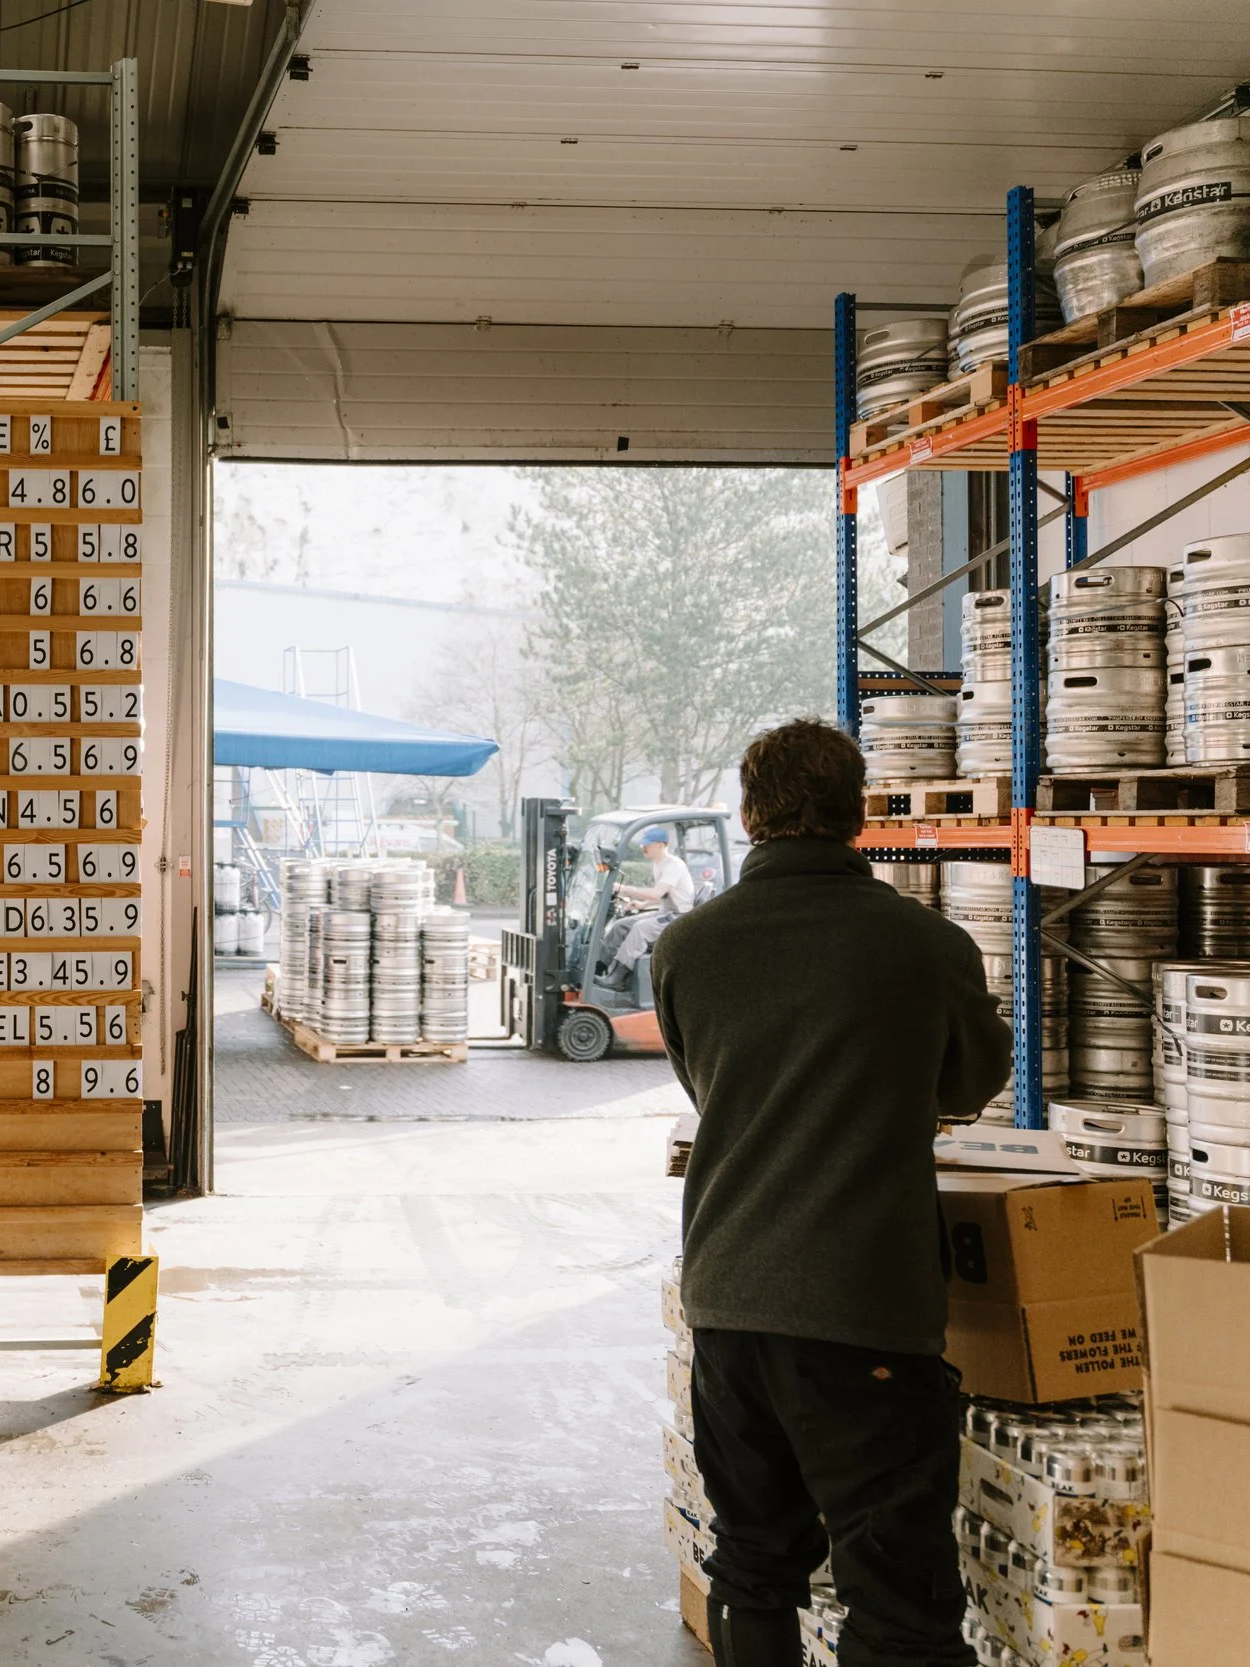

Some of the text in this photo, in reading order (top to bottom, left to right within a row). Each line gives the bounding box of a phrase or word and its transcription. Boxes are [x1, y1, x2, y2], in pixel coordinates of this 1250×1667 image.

[32, 423, 50, 450] %
[104, 425, 117, 451] £
[11, 477, 67, 504] 4.8
[81, 478, 136, 504] 6.0
[34, 532, 49, 557] 5
[81, 532, 138, 558] 5.8
[33, 583, 49, 610] 6
[82, 584, 137, 612] 6.6
[1204, 601, 1228, 610] Kegstar
[32, 638, 47, 664] 5
[79, 639, 134, 665] 6.8
[13, 691, 68, 718] 0.5
[84, 691, 138, 718] 5.2
[1115, 724, 1141, 732] Kegstar
[11, 742, 66, 772] 6.5
[84, 744, 138, 771] 6.9
[20, 798, 76, 824] 4.5
[99, 798, 114, 824] 6
[7, 852, 62, 878] 6.5
[82, 850, 136, 878] 6.9
[546, 848, 557, 891] TOYOTA
[30, 905, 76, 933] 6.3
[84, 903, 139, 931] 5.9
[14, 959, 69, 986] 3.4
[75, 959, 129, 986] 5.9
[38, 1012, 92, 1041] 5.5
[109, 1013, 124, 1040] 6
[36, 1068, 50, 1094] 8
[84, 1068, 139, 1094] 9.6
[1068, 1328, 1137, 1346] WE FEED ON
[1112, 1343, 1133, 1355] THE
[1059, 1346, 1109, 1362] FLOWERS
[1075, 1356, 1140, 1373] THE POLLEN
[1051, 1482, 1075, 1492] BEAK
